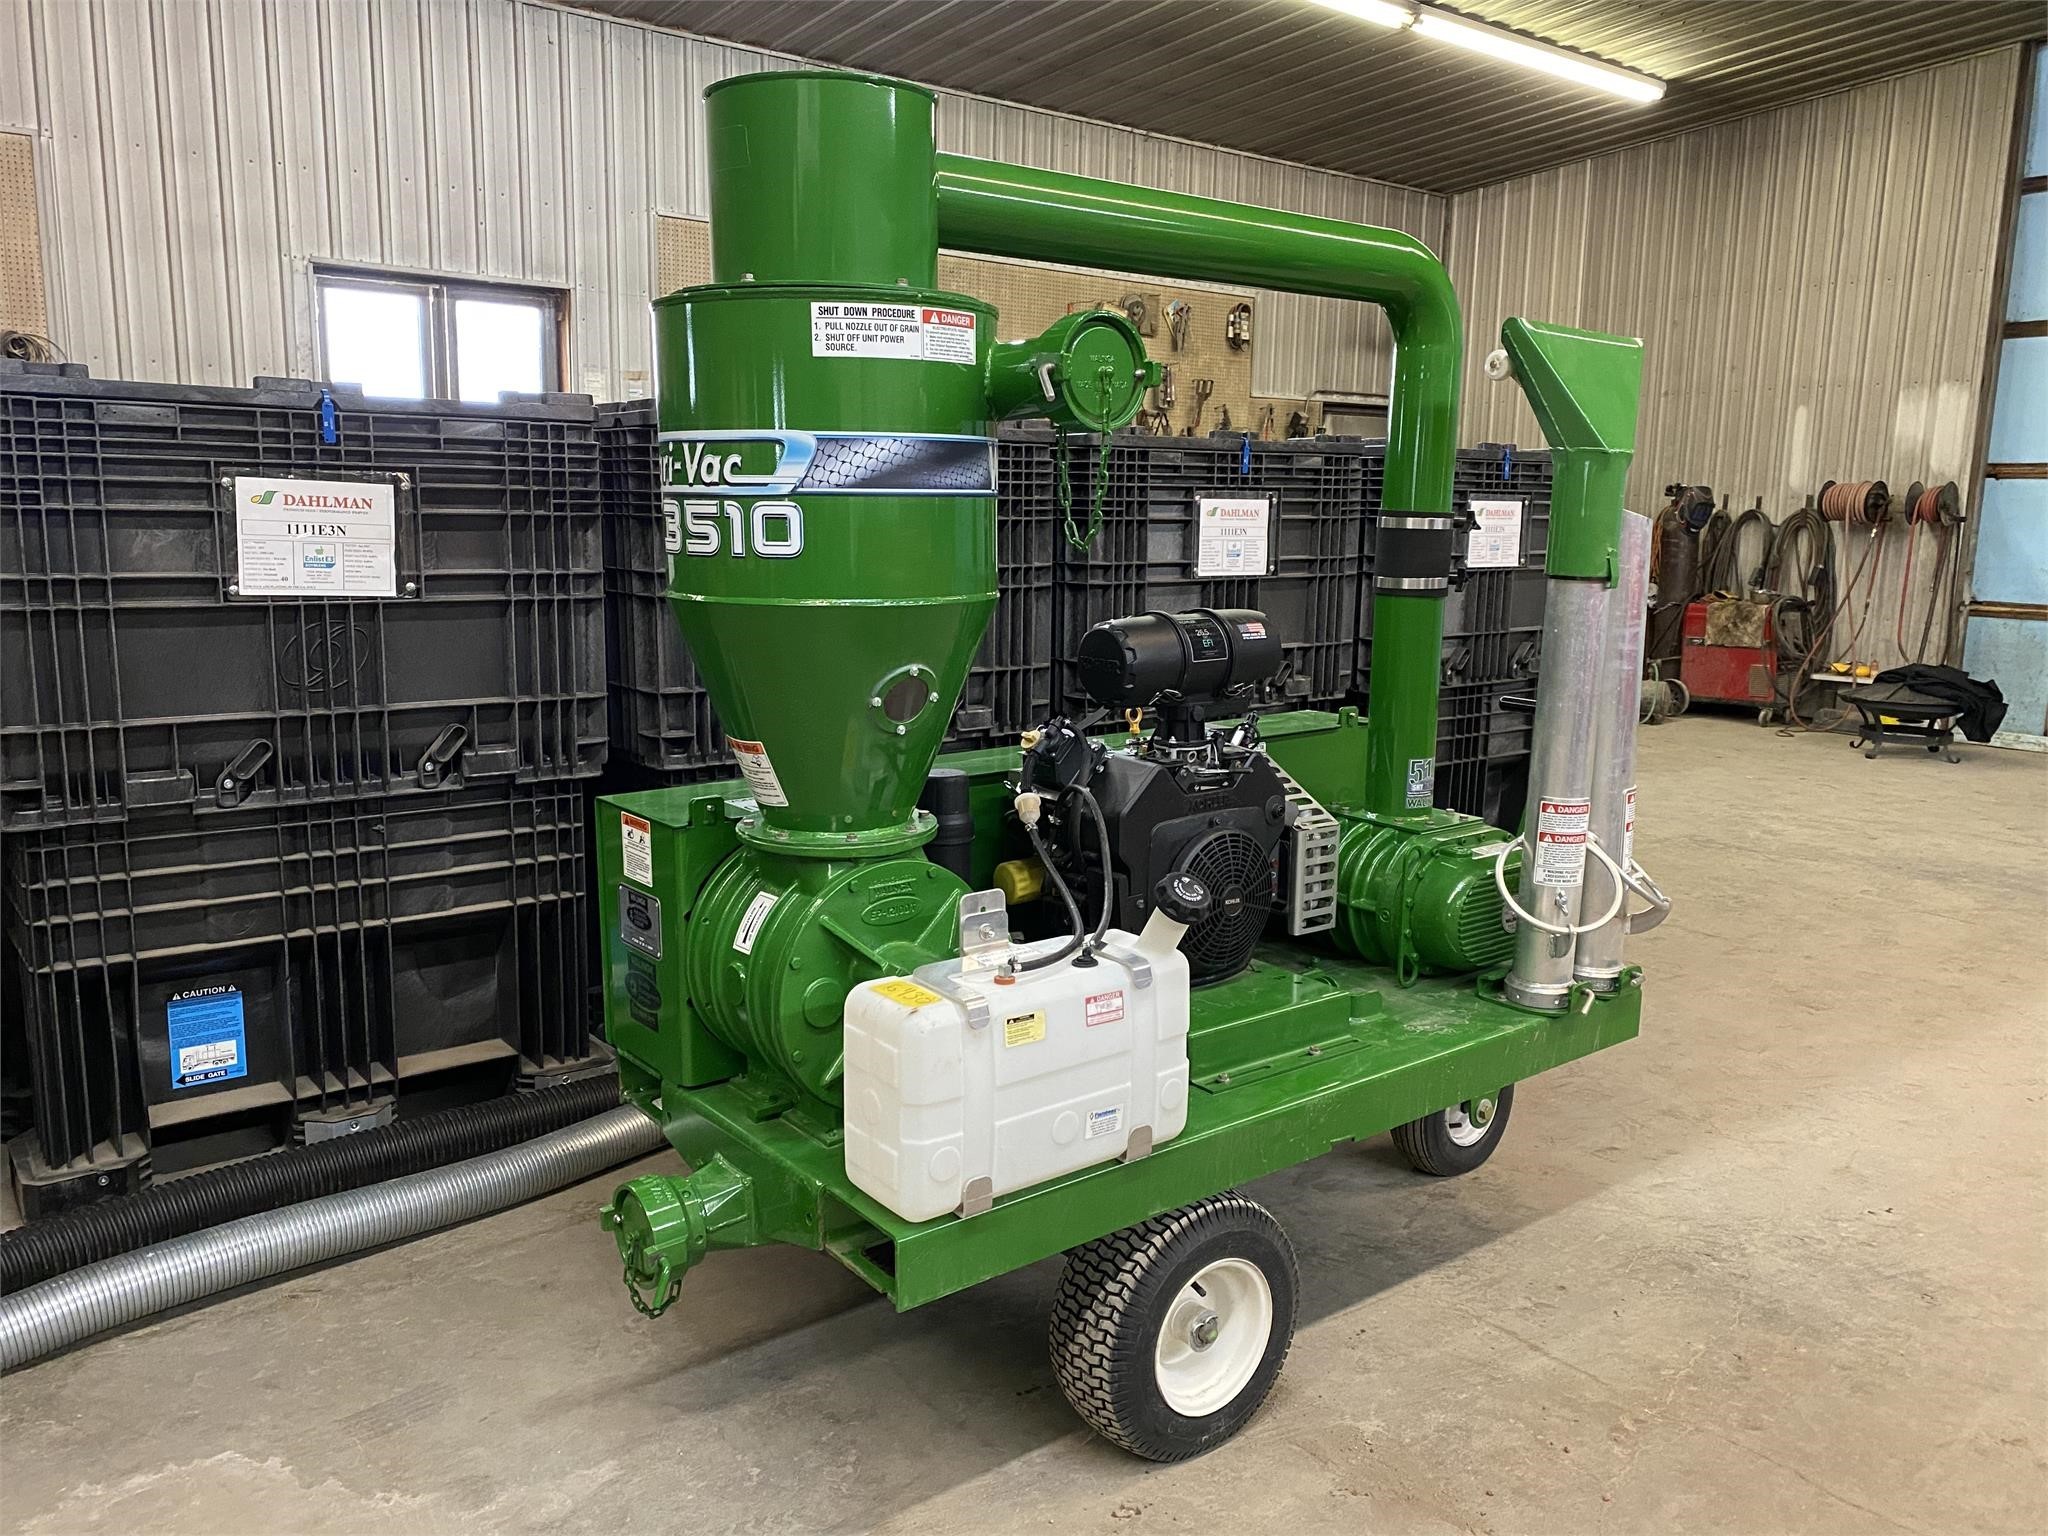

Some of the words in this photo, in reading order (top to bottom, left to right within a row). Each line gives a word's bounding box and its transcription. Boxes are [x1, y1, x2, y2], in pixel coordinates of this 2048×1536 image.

[818, 305, 839, 316] SHUT
[843, 306, 868, 317] DOWN
[872, 307, 916, 319] PROCEDURE
[941, 313, 970, 326] DANGER
[814, 322, 821, 330] 1.
[825, 322, 844, 330] PULL
[845, 322, 871, 331] NOZZLE
[874, 323, 888, 332] OUT
[889, 324, 898, 332] OF
[899, 324, 920, 333] GRAIN
[814, 333, 821, 341] 2.
[825, 333, 845, 342] SHUT
[846, 334, 861, 342] OFF
[862, 334, 878, 343] UNIT
[880, 335, 905, 344] POWER
[283, 494, 374, 510] DAHLMAN
[1220, 508, 1260, 517] DAHLMAN
[287, 523, 347, 537] 1111E3N
[1557, 806, 1588, 814] DANGER
[1555, 834, 1585, 843] DANGER
[182, 986, 226, 999] CAUTION
[1096, 990, 1121, 1003] DANGER
[185, 1074, 206, 1083] SLIDE
[207, 1070, 226, 1078] GATE
